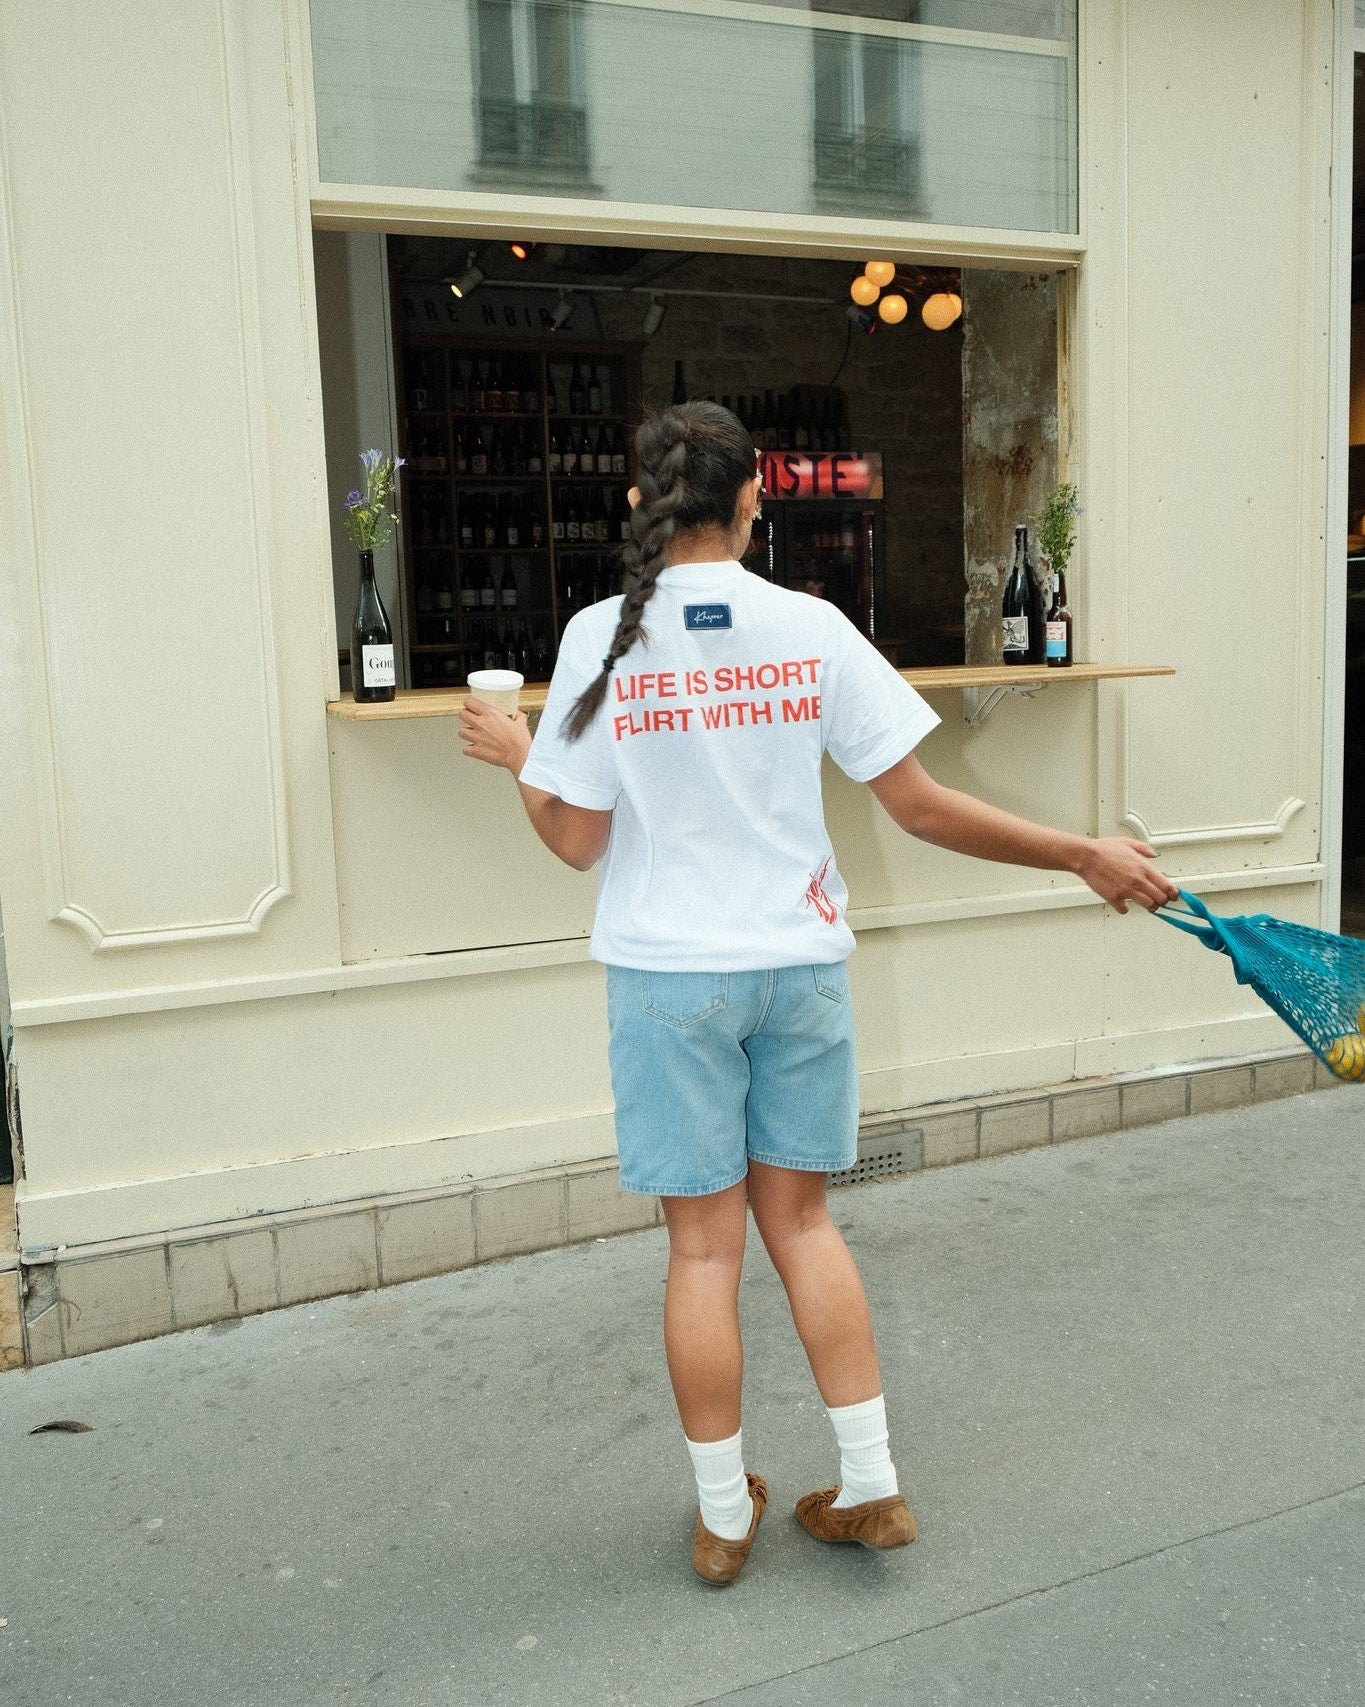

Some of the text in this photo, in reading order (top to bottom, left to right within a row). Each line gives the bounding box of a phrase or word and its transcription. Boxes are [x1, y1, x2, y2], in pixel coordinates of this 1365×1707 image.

[615, 658, 821, 703] LIFE IS SHORT
[613, 695, 821, 741] FLIRT WITH ME
